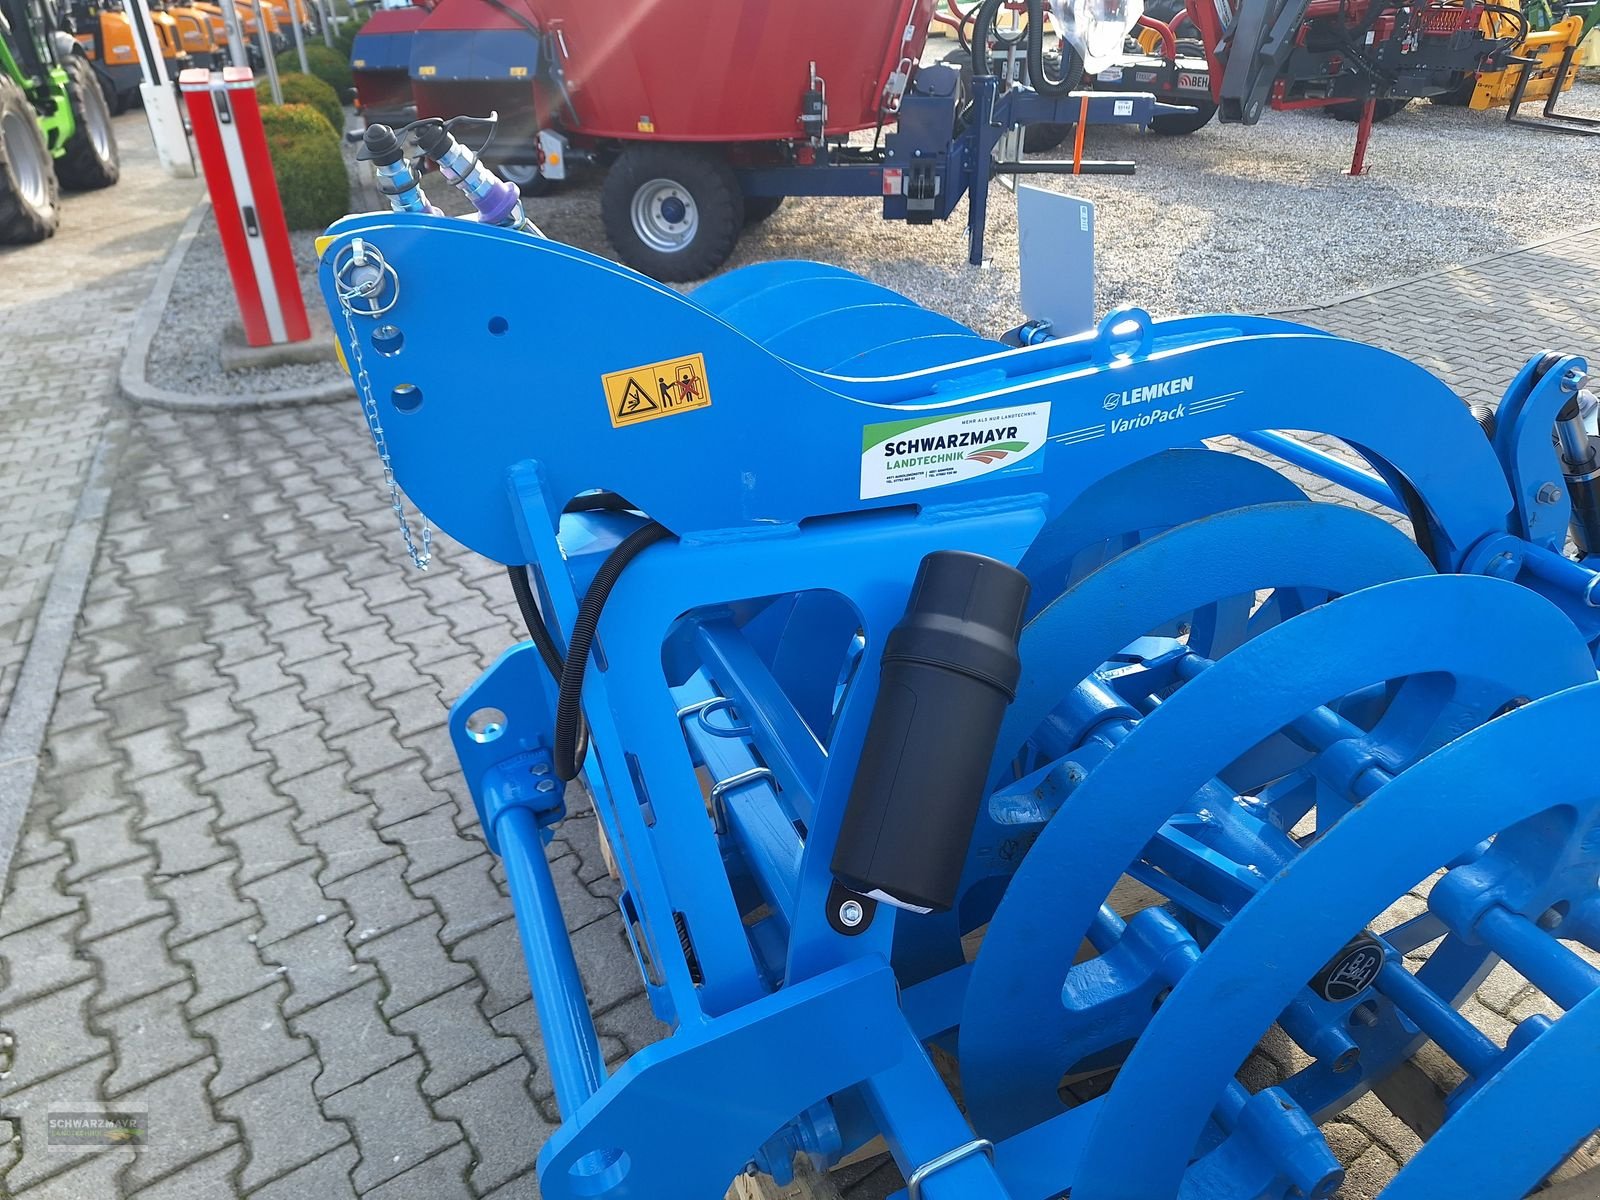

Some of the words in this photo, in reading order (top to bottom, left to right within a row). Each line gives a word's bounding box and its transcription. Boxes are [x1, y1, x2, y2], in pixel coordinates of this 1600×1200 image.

[1192, 76, 1208, 88] BEH
[1121, 375, 1194, 406] LEMKEN
[1110, 403, 1186, 434] VarioPack
[884, 426, 1018, 457] SCHWARZMAYR
[886, 451, 964, 470] LANDTECHNIK
